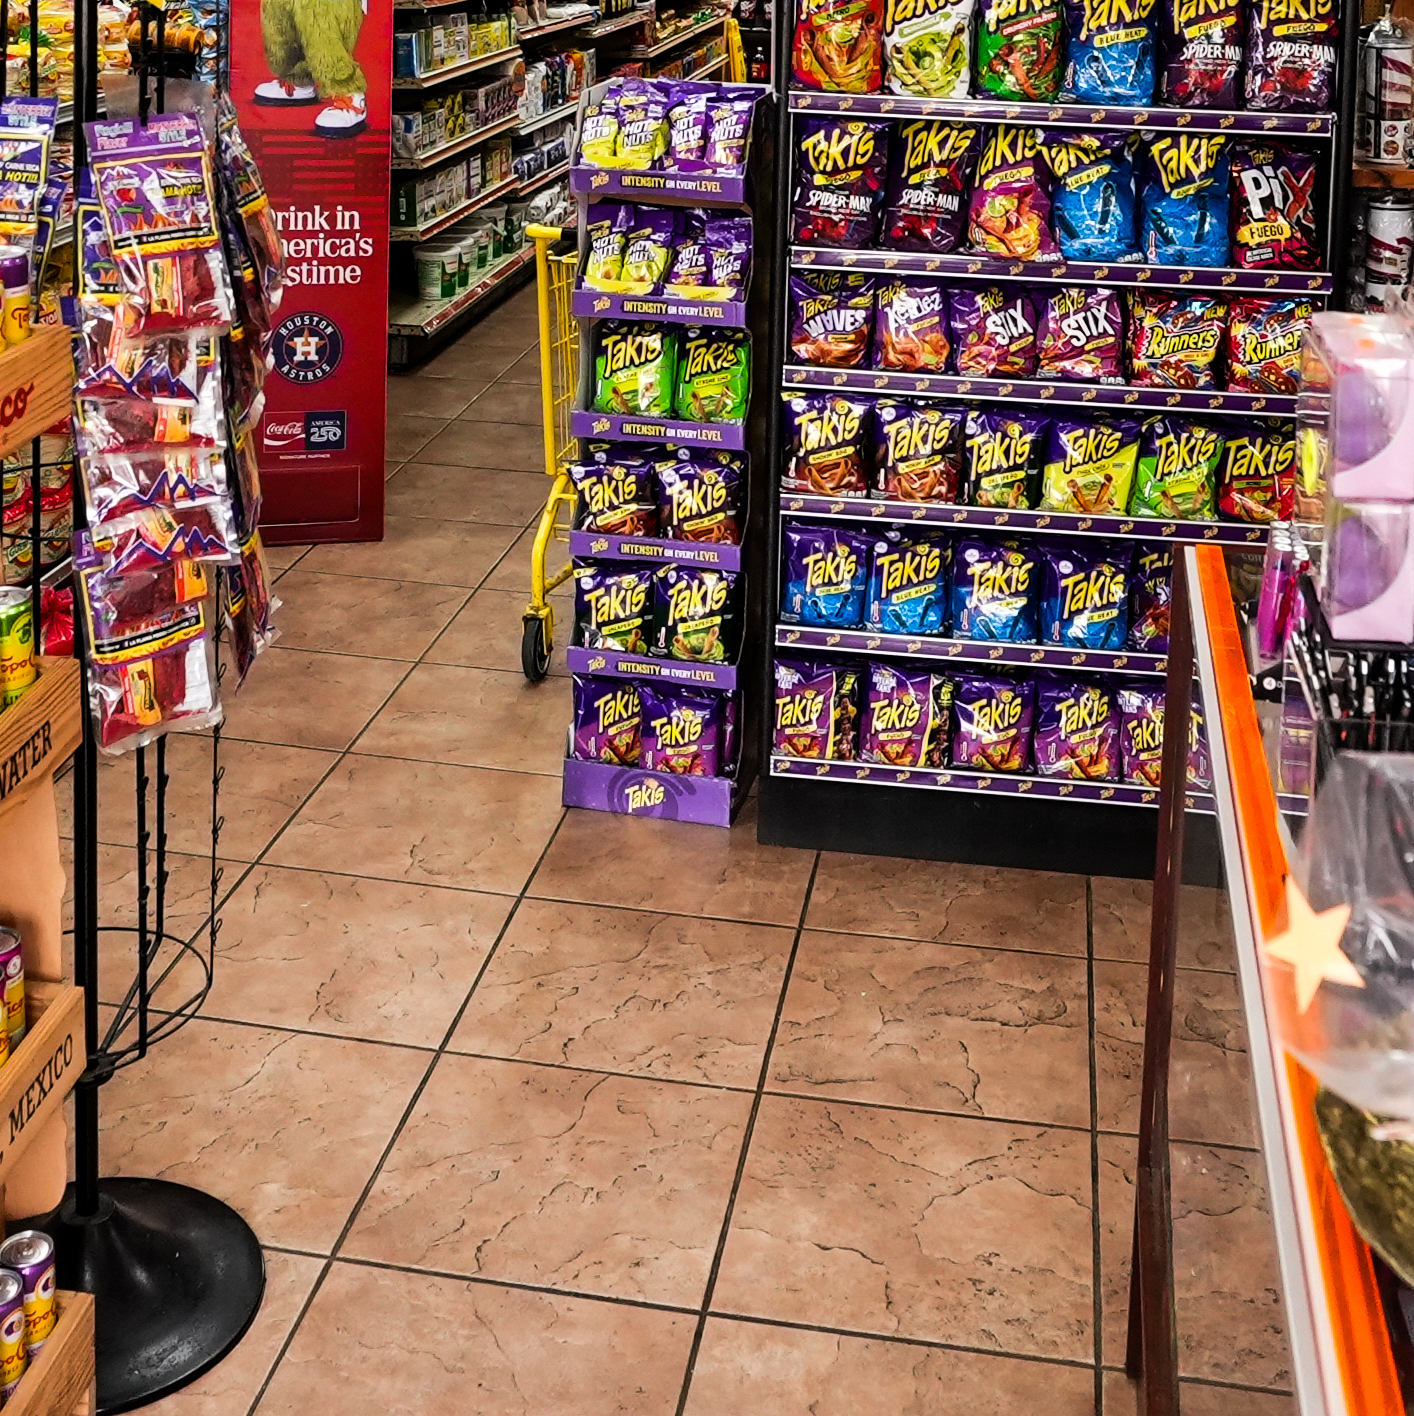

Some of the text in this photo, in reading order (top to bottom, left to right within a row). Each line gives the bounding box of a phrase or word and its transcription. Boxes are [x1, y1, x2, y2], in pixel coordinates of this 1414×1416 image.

[621, 175, 723, 193] INTENSITY LEVEL
[271, 205, 361, 232] rink in
[286, 260, 362, 286] stime
[278, 315, 335, 337] HOUSTON
[987, 303, 1033, 347] STIX
[1145, 325, 1220, 361] Runners
[280, 362, 332, 382] ASTROS
[310, 426, 342, 442] 250
[6, 1032, 76, 1142] MEXICO
